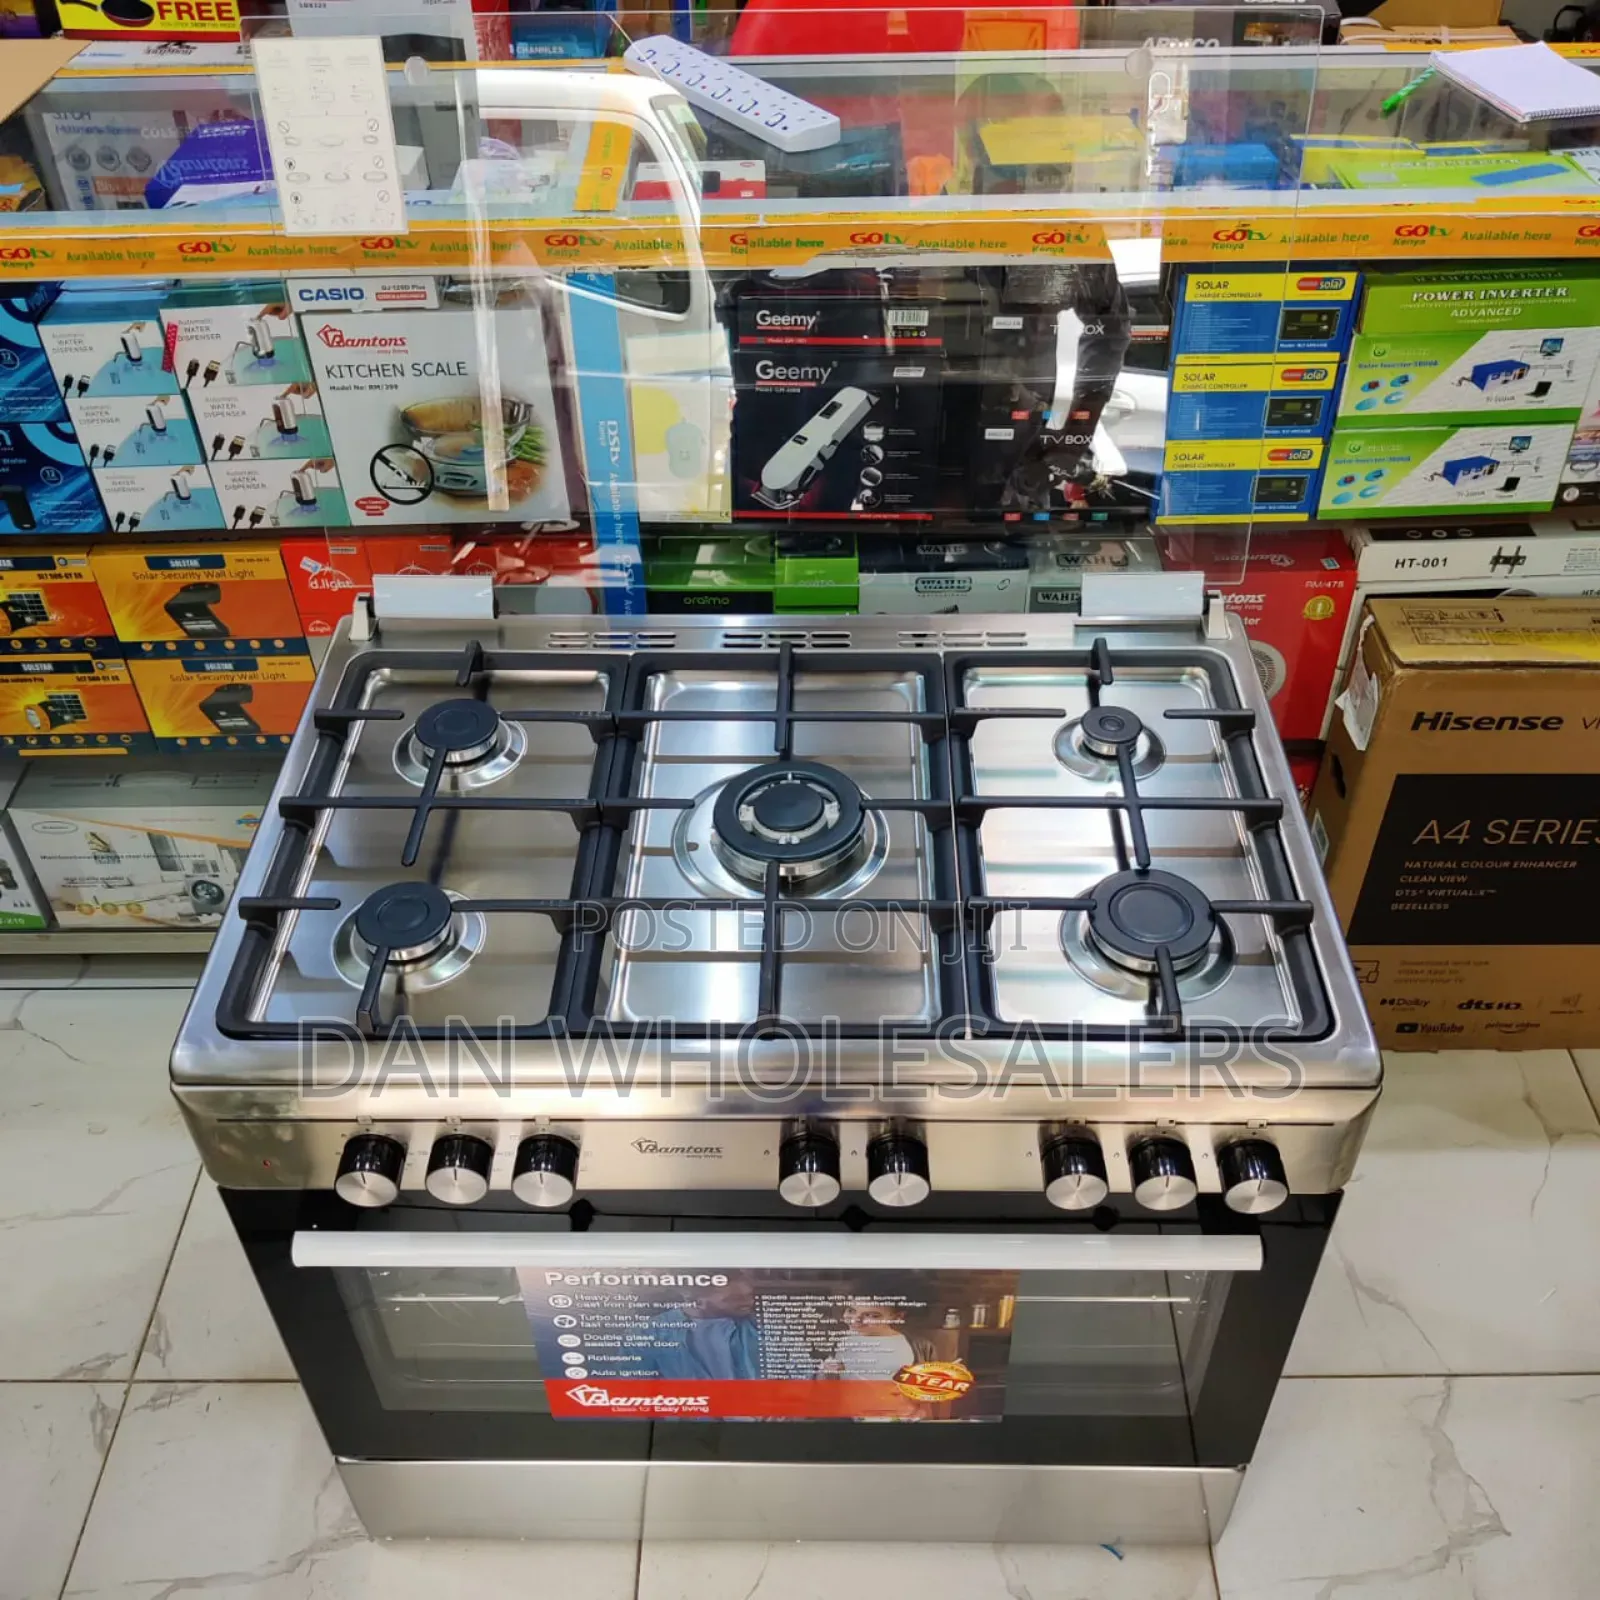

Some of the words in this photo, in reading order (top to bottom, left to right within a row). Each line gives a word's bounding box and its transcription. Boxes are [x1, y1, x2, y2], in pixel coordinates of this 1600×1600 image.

[156, 1, 236, 21] FREE
[1213, 228, 1272, 242] GOtv
[1394, 224, 1454, 237] GOtv
[1461, 231, 1520, 242] Available
[1523, 231, 1552, 241] here
[360, 236, 421, 251] GOtv
[544, 234, 606, 248] GOtv
[613, 237, 672, 251] Available
[796, 237, 824, 248] here
[850, 231, 906, 245] GOtv
[1032, 231, 1090, 245] GOtv
[1280, 233, 1338, 244] Available
[1341, 232, 1370, 243] here
[177, 240, 236, 255] GOtv
[247, 244, 304, 256] Available
[308, 244, 338, 255] here
[917, 239, 977, 250] Available
[979, 239, 1008, 249] here
[66, 251, 125, 262] Available
[127, 248, 156, 260] here
[1196, 280, 1229, 290] SOLAR
[299, 288, 365, 301] CASIO
[1411, 290, 1476, 301] POWER
[1479, 286, 1569, 299] INVERTER
[1450, 307, 1522, 318] ADVANCED
[756, 310, 816, 330] Geemy
[177, 333, 221, 342] DISPENSER
[316, 324, 407, 348] Ramtons
[325, 364, 405, 379] KITCHEN
[412, 362, 468, 376] SCALE
[756, 361, 832, 385] Geemy
[1184, 372, 1216, 382] SOLAR
[209, 403, 237, 411] WATER
[1040, 435, 1064, 444] TV
[1065, 435, 1093, 444] BOX
[1173, 452, 1205, 461] SOLAR
[609, 472, 621, 519] Available
[168, 558, 199, 568] SOLSTAR
[1063, 555, 1123, 565] WAHL
[1395, 557, 1448, 569] HT-001
[132, 571, 159, 581] Solar
[160, 570, 201, 581] Security
[204, 570, 228, 579] Wall
[230, 569, 255, 580] Light
[310, 577, 354, 592] d.light
[683, 596, 730, 605] oraimo
[170, 674, 195, 683] Solar
[196, 673, 235, 684] Security
[237, 672, 259, 681] Wall
[261, 672, 287, 682] Light
[1411, 712, 1564, 731] Hisense
[1412, 819, 1471, 845] A4
[1404, 861, 1457, 869] NATURAL
[1461, 861, 1510, 869] COLOUR
[1513, 861, 1577, 869] ENHANCER
[1400, 875, 1436, 883] CLEAN
[1440, 875, 1467, 883] VIEW
[1420, 1023, 1464, 1033] YouTube
[631, 1136, 723, 1154] Ramtons
[544, 1271, 728, 1287] Performance
[575, 1294, 610, 1302] Heavy
[612, 1293, 639, 1301] duty
[604, 1321, 649, 1329] cooking
[619, 1369, 659, 1377] ignition
[915, 1375, 970, 1392] YEAR
[565, 1384, 710, 1406] Ramtons
[654, 1405, 679, 1413] Easy
